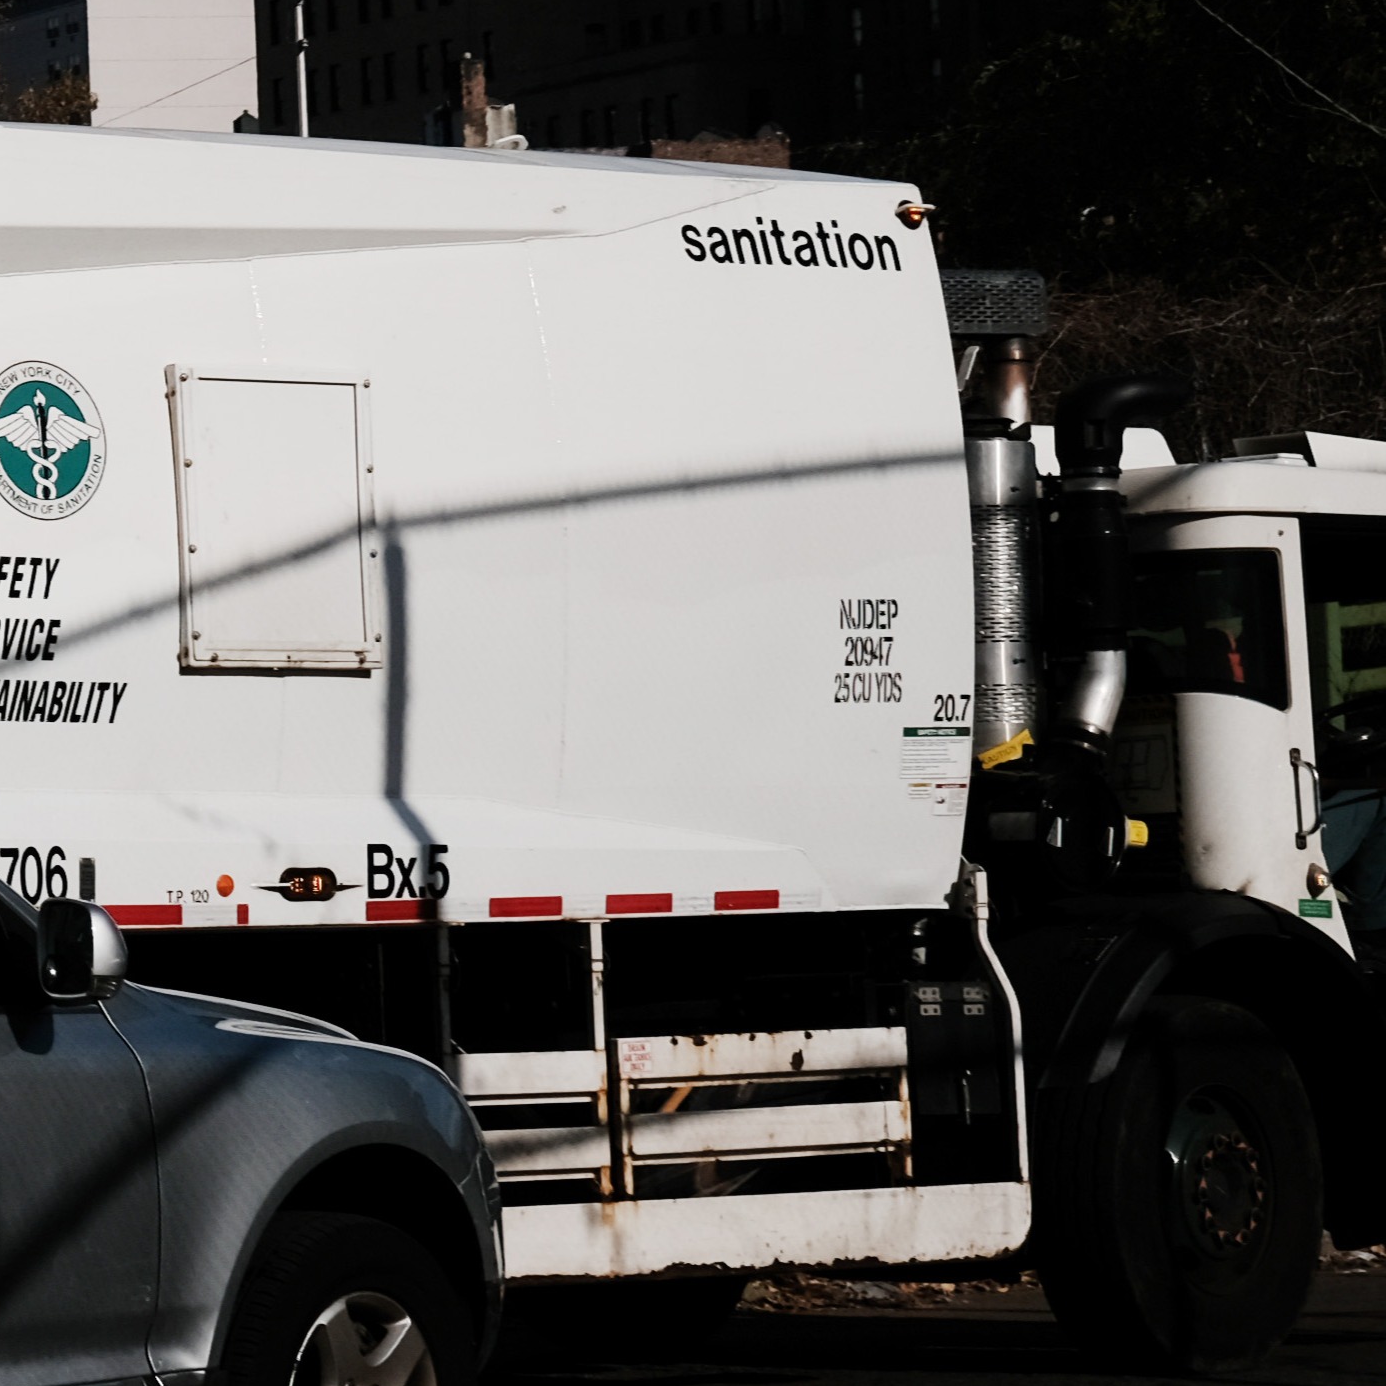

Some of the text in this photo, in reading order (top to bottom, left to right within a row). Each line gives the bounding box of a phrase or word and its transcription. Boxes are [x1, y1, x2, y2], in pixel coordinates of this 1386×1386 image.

[681, 218, 902, 271] sanitation
[20, 366, 52, 380] YORK
[55, 373, 81, 396] CITY
[40, 504, 54, 514] OF
[58, 454, 103, 514] SANITATION
[839, 598, 899, 630] NJDEP
[844, 636, 894, 666] 20947
[852, 673, 872, 703] CU
[875, 672, 903, 703] YDS
[933, 694, 971, 722] 20.7
[366, 843, 450, 900] Bx.5
[190, 889, 210, 903] 120
